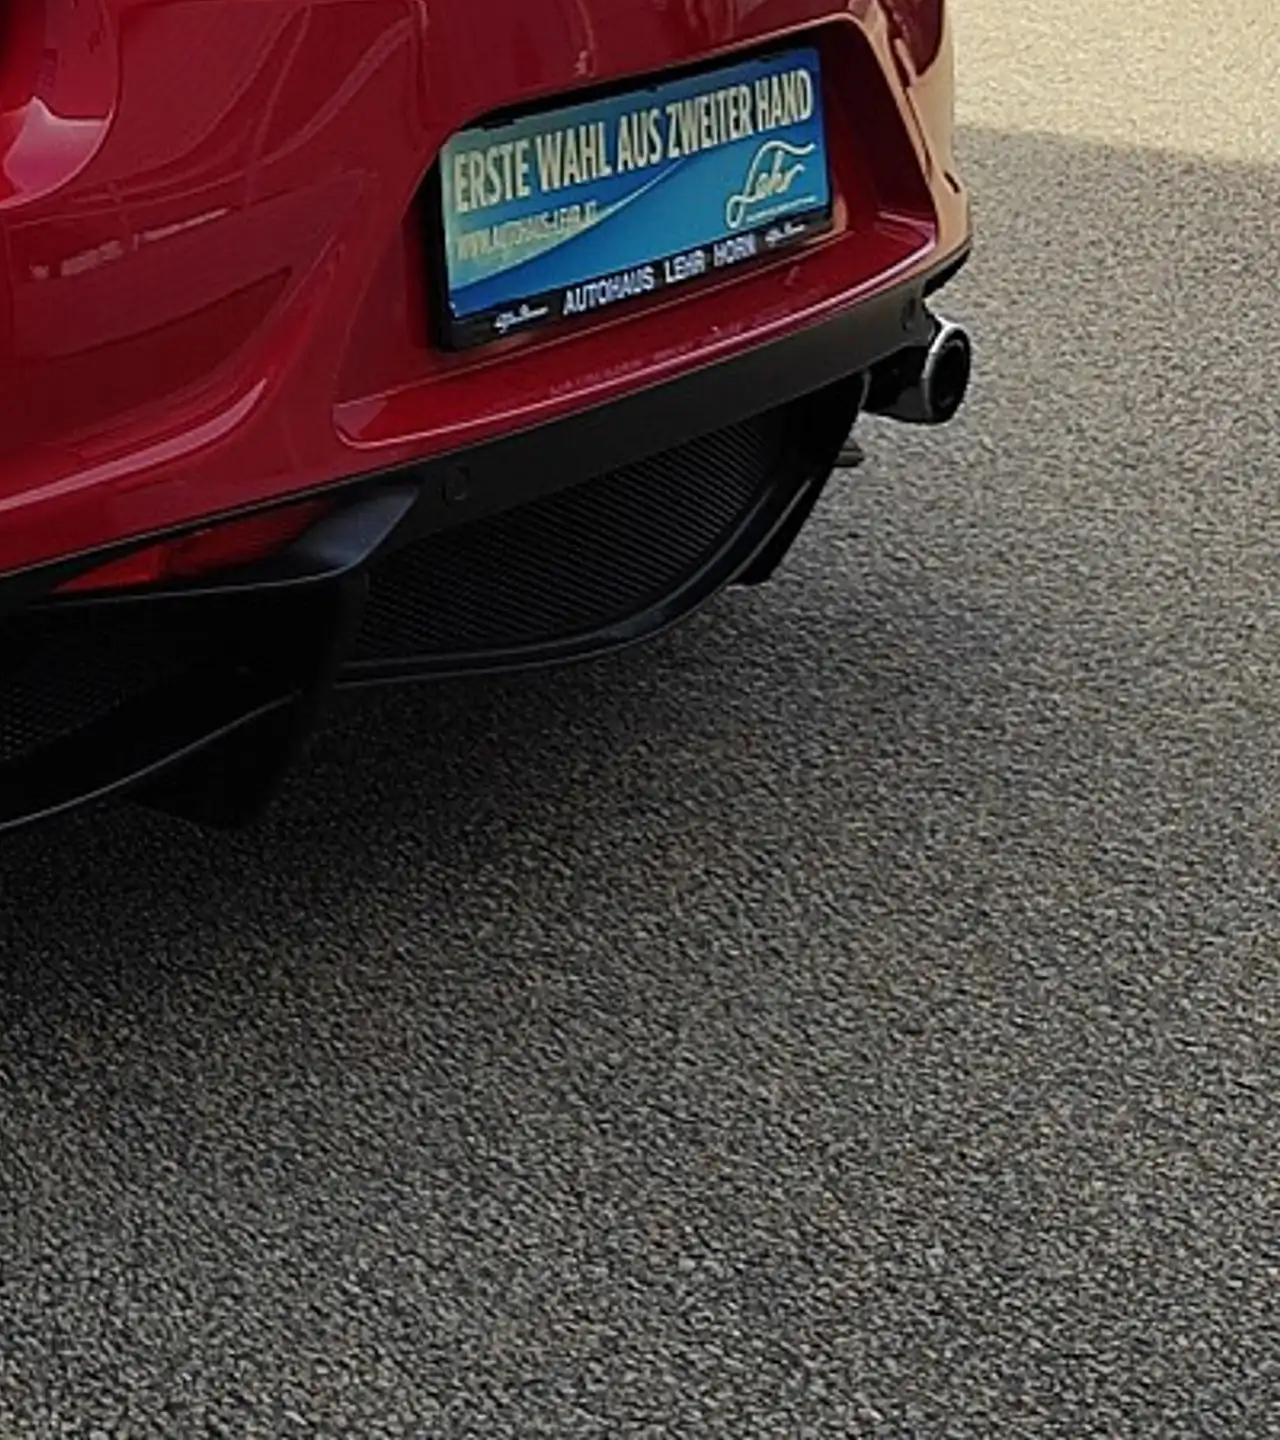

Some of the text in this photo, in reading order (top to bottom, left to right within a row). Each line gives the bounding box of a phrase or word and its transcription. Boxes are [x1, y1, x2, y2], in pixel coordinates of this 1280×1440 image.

[453, 68, 814, 213] ERSTE WAHL AUS ZWEITER HAND
[562, 266, 656, 316] AUTOHAUS
[664, 248, 706, 284] LEHR
[713, 233, 758, 268] HORN
